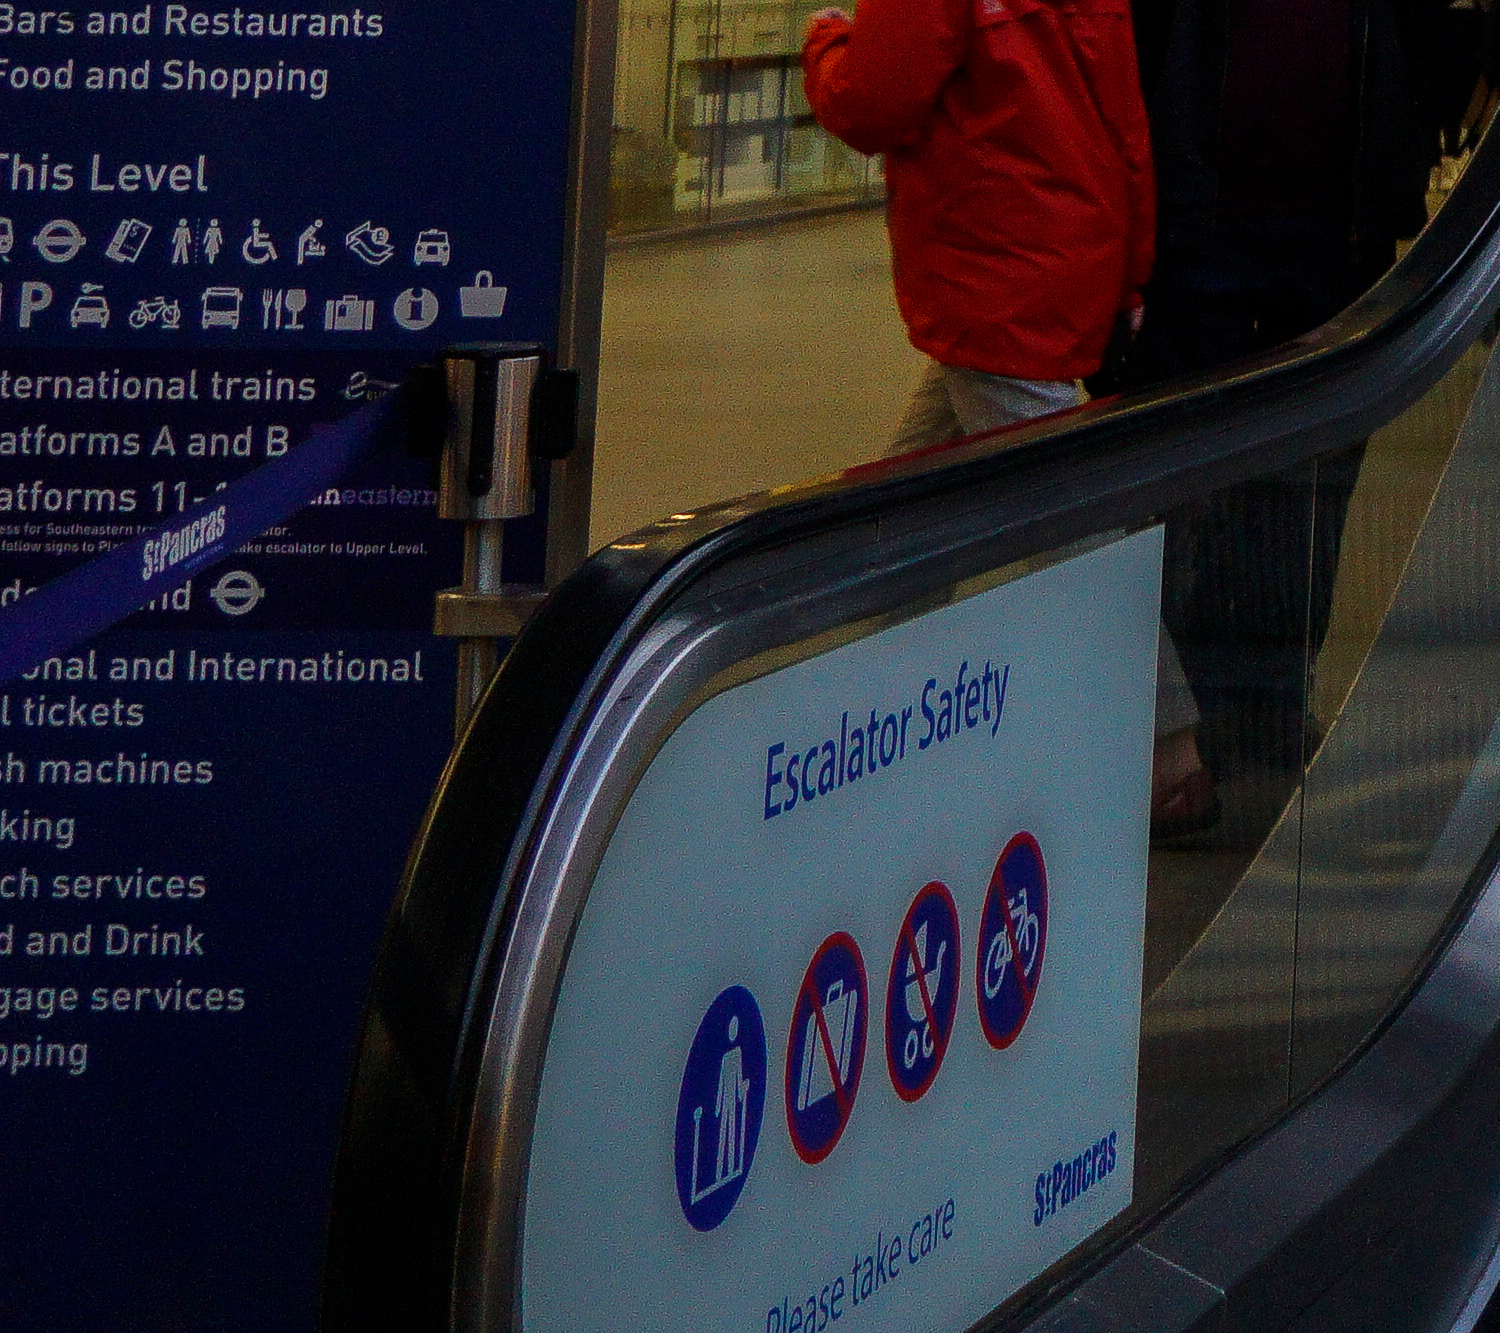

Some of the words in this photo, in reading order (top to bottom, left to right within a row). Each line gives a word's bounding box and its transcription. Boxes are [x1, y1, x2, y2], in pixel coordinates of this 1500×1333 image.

[87, 5, 151, 35] and
[164, 5, 383, 36] Restaurants
[85, 61, 150, 90] and
[161, 60, 329, 100] Shopping
[90, 153, 208, 192] Level
[212, 369, 316, 401] trains
[152, 425, 177, 456] A
[187, 426, 252, 456] and
[266, 426, 290, 457] B
[109, 650, 174, 681] and
[188, 650, 422, 681] International
[23, 695, 144, 726] tickets
[918, 660, 1012, 748] Safety
[39, 752, 212, 784] machines
[763, 705, 912, 821] Escalator
[52, 867, 205, 899] services
[25, 924, 91, 955] and
[105, 924, 203, 956] Drink
[91, 980, 245, 1013] services
[766, 1271, 845, 1333] Please
[851, 1229, 900, 1305] take
[907, 1197, 956, 1269] care
